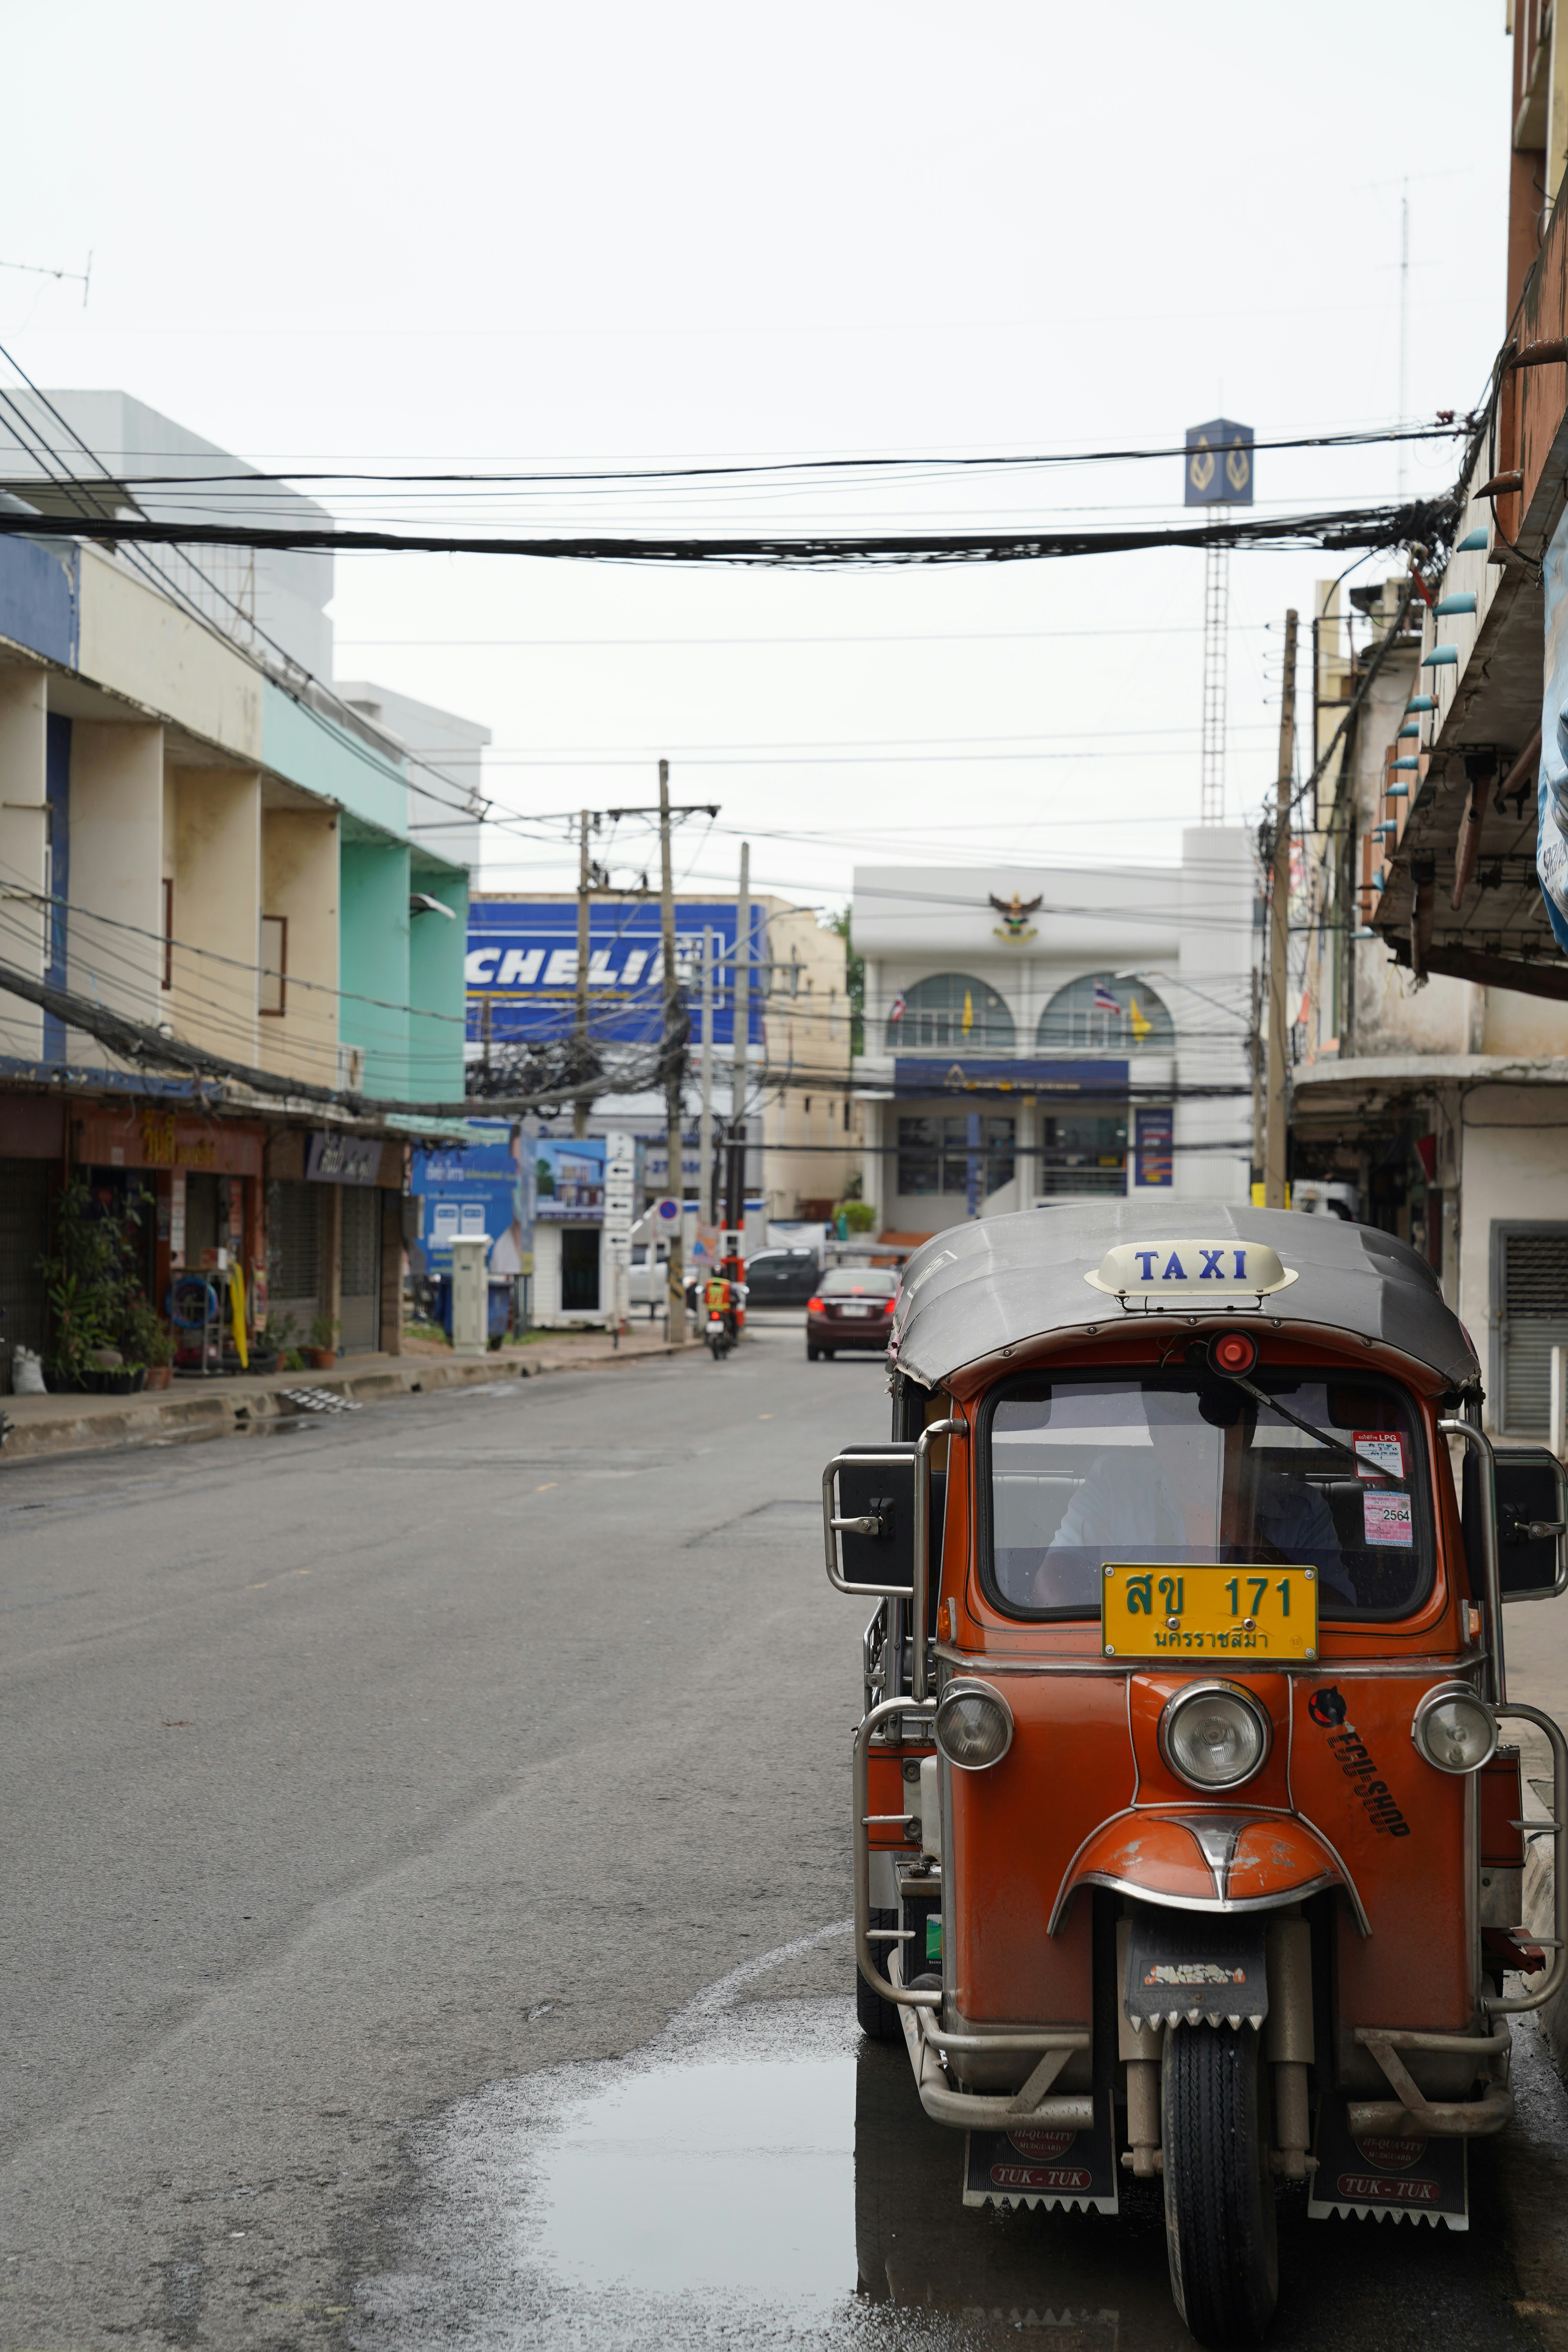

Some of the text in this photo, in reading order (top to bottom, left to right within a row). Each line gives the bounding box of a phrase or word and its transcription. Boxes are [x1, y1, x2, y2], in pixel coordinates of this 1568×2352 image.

[1135, 1250, 1247, 1280] TAXI
[1384, 1510, 1410, 1521] 2564
[1126, 1572, 1289, 1616] สข 171
[1154, 1627, 1269, 1648] นครราชสีมา
[1014, 2129, 1073, 2141] HI-QUALITY
[1019, 2141, 1061, 2151] MUDGUARD
[1363, 2137, 1424, 2152] HI-QUALITY
[998, 2168, 1034, 2184] TUK
[1048, 2171, 1084, 2186] TUK
[1345, 2178, 1382, 2194] TUK
[1396, 2182, 1433, 2199] TUK
